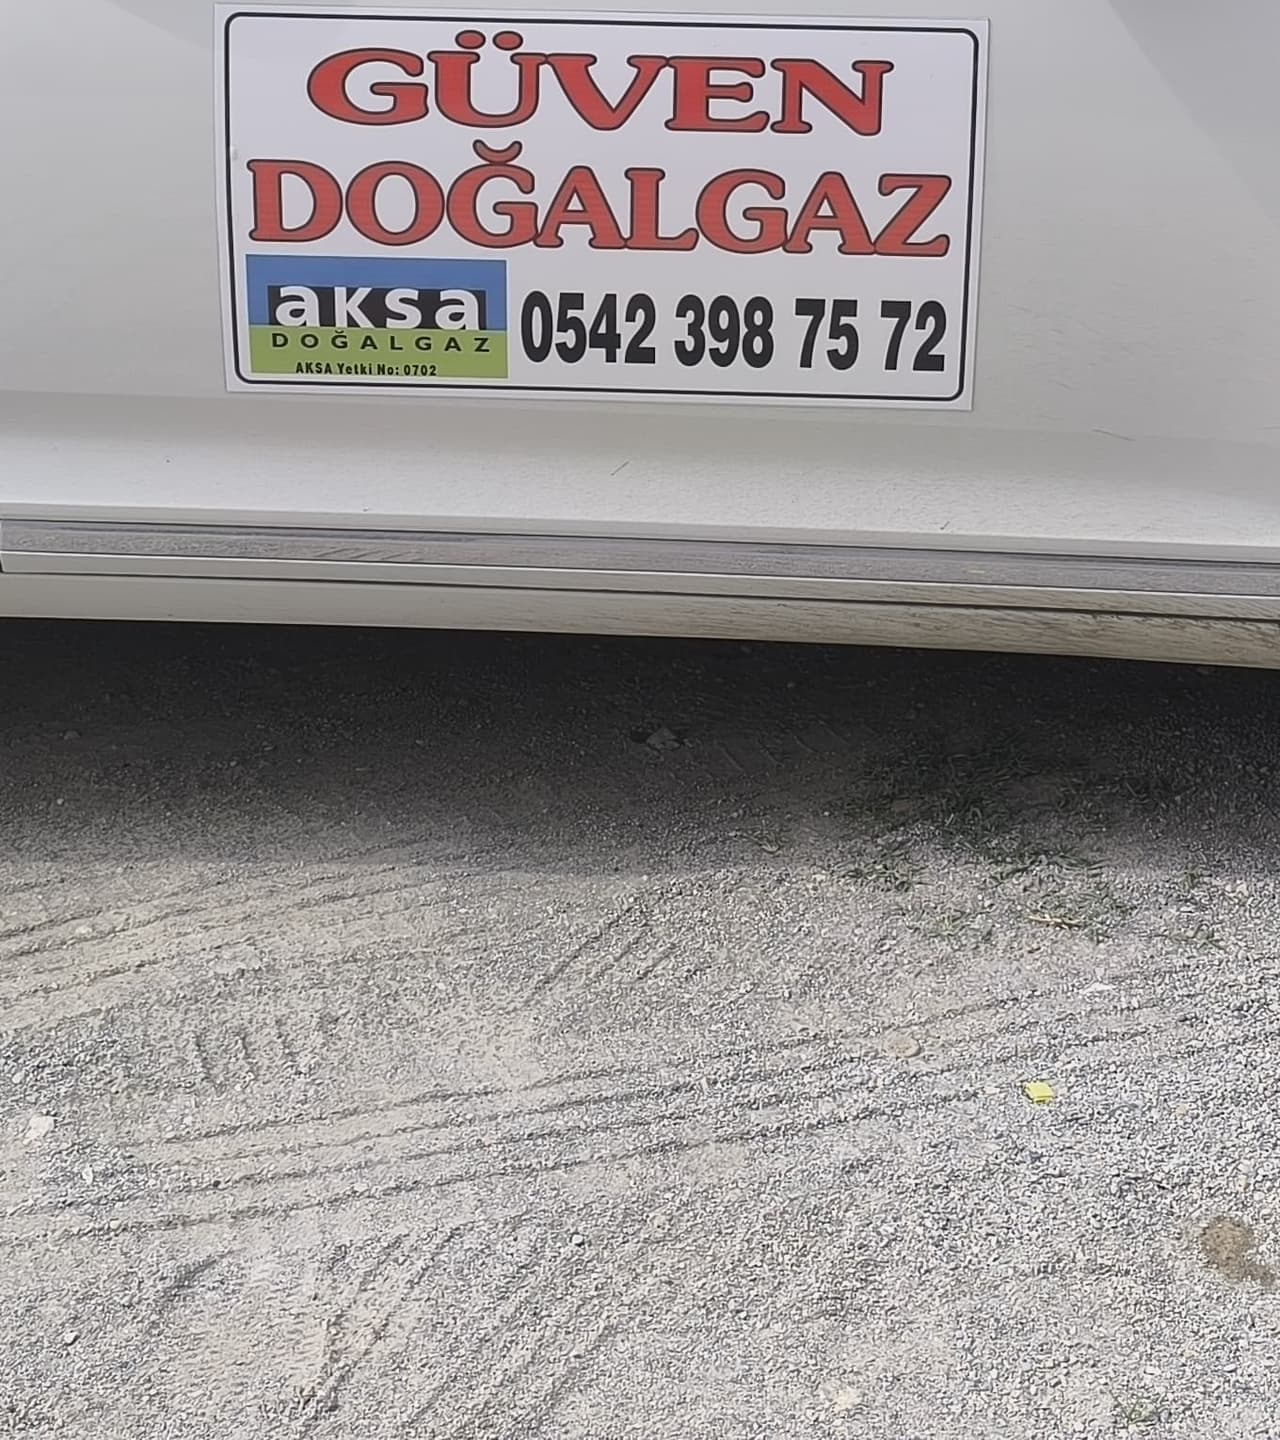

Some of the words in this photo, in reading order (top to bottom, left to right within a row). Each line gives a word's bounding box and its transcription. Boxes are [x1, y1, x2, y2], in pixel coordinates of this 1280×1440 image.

[307, 30, 894, 136] GÜVEN
[246, 140, 951, 257] DOĞALGAZ
[275, 286, 480, 330] aksa
[520, 291, 656, 366] 0542
[674, 295, 774, 369] 398
[794, 298, 859, 371] 75
[880, 301, 947, 372] 72
[271, 330, 491, 353] DOĞALGAZ
[295, 361, 332, 375] AKSA
[337, 362, 373, 376] Yetki
[376, 364, 400, 377] No:
[403, 363, 437, 377] 0702
